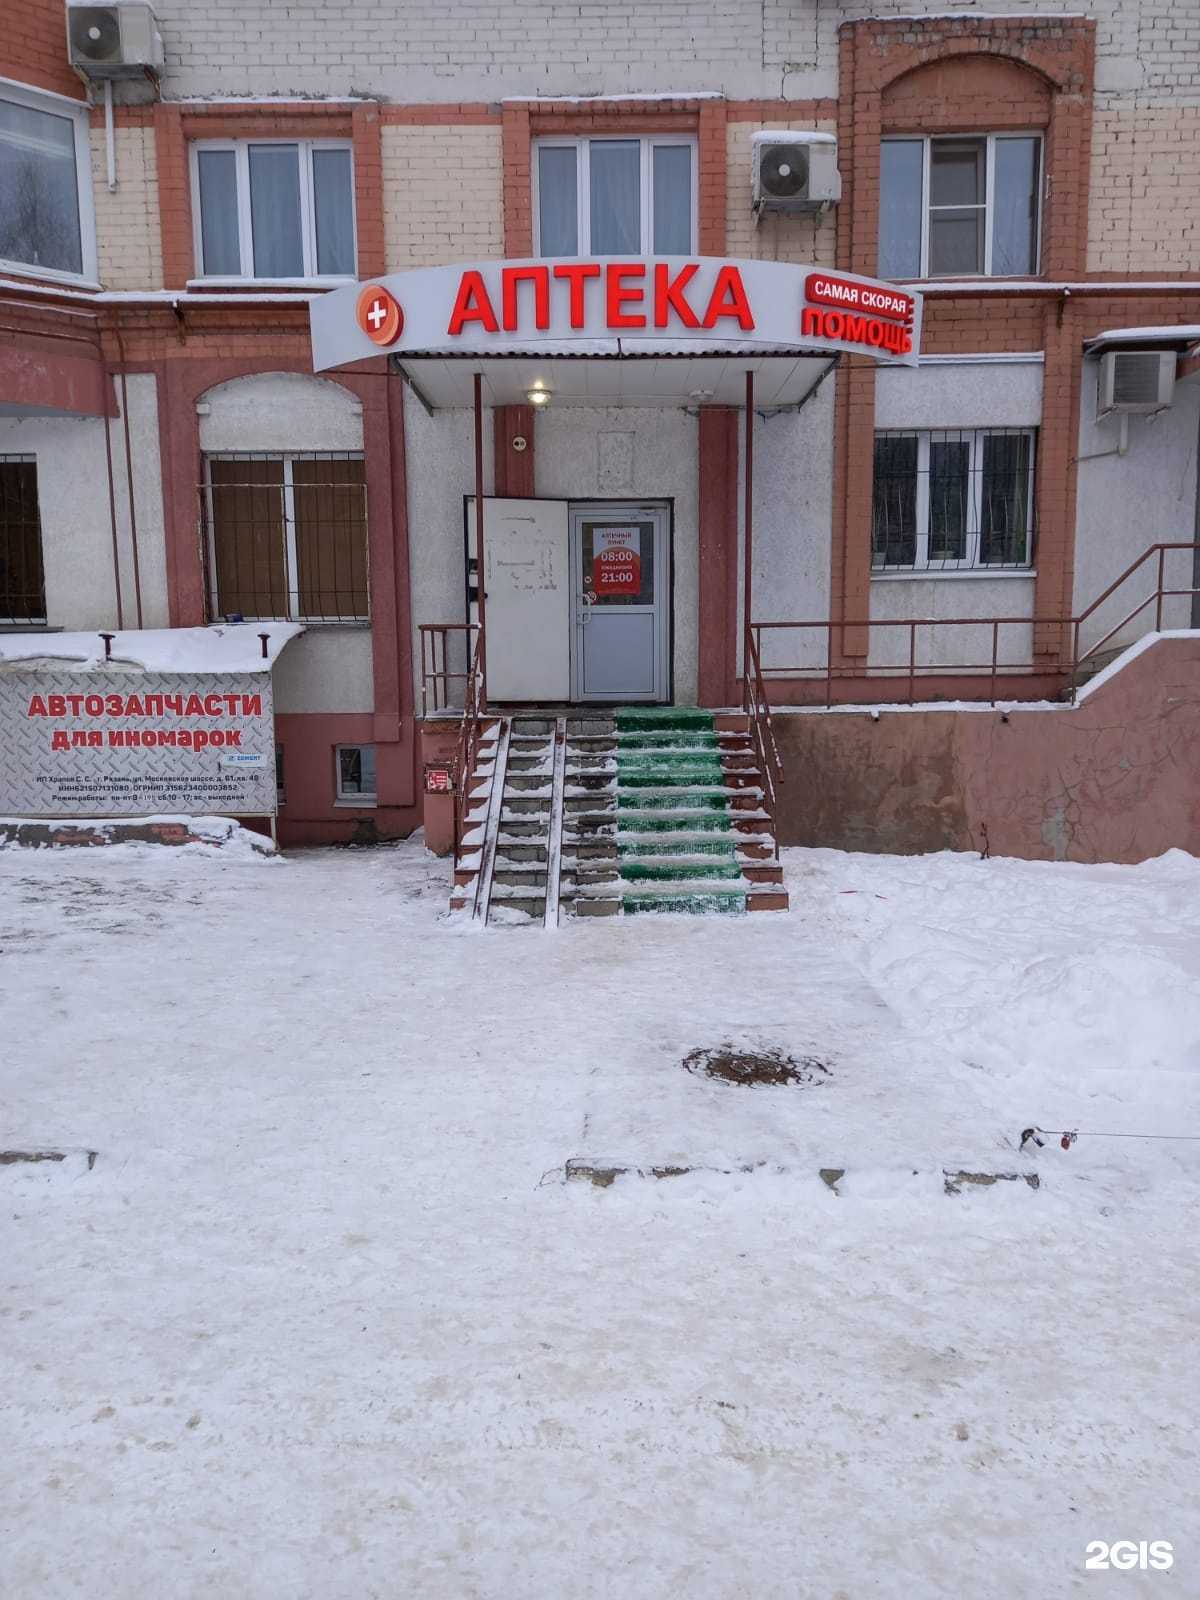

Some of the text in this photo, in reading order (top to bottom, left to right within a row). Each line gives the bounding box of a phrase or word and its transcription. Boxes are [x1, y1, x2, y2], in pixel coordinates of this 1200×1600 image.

[447, 263, 756, 336] АПТЕКА
[815, 281, 906, 313] САМАЯ СКОРАЯ
[801, 306, 913, 355] ПОМОЩЬ
[601, 551, 633, 562] 08:00
[601, 572, 633, 583] 21:00
[27, 694, 262, 717] АВТОЗАПЧАСТИ
[51, 729, 242, 752] для иномарок
